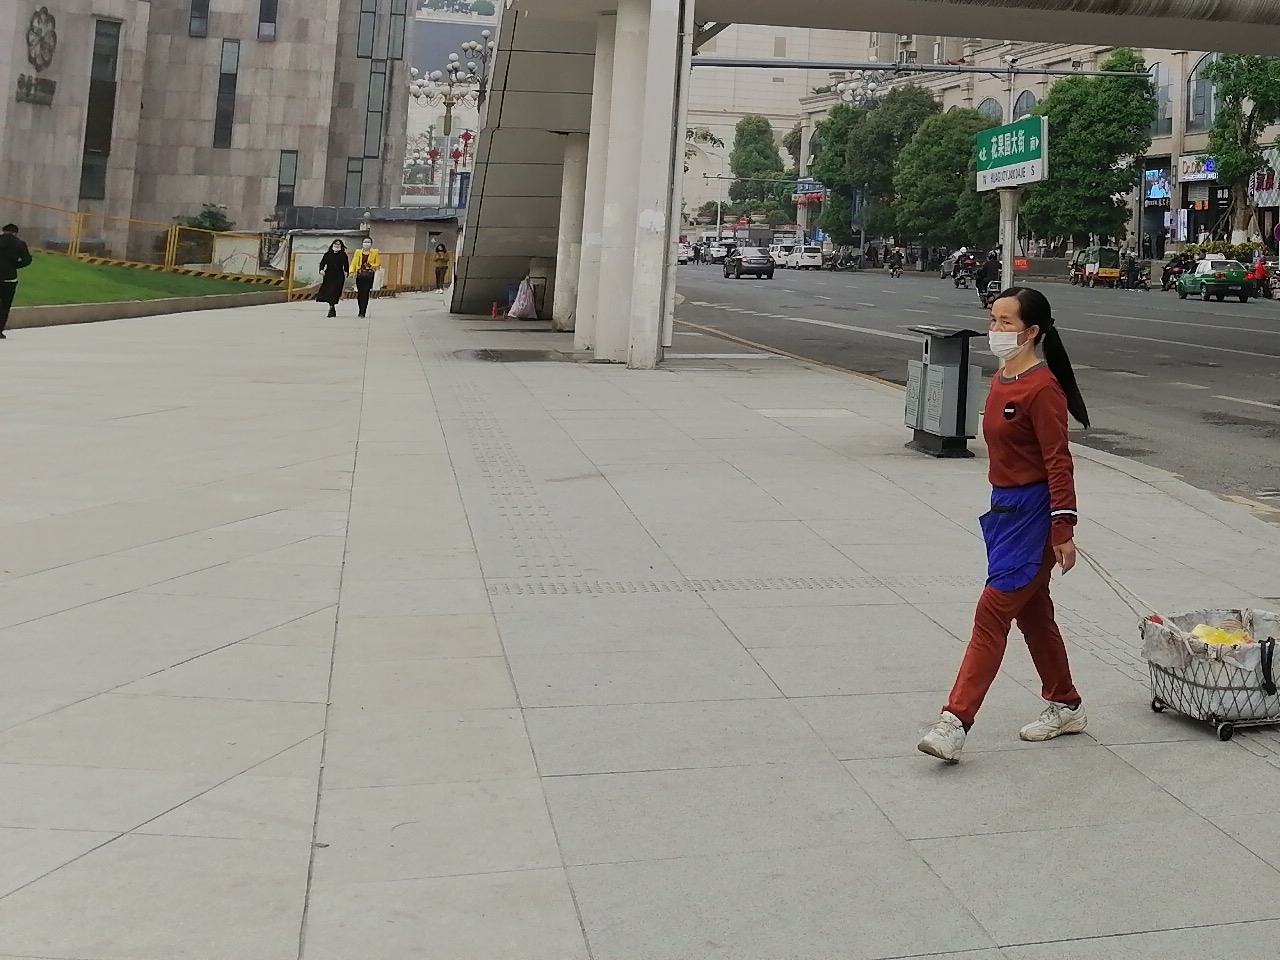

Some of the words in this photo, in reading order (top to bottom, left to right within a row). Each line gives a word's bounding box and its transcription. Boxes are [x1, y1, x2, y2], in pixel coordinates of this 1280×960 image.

[991, 129, 1025, 160] 花果园大街
